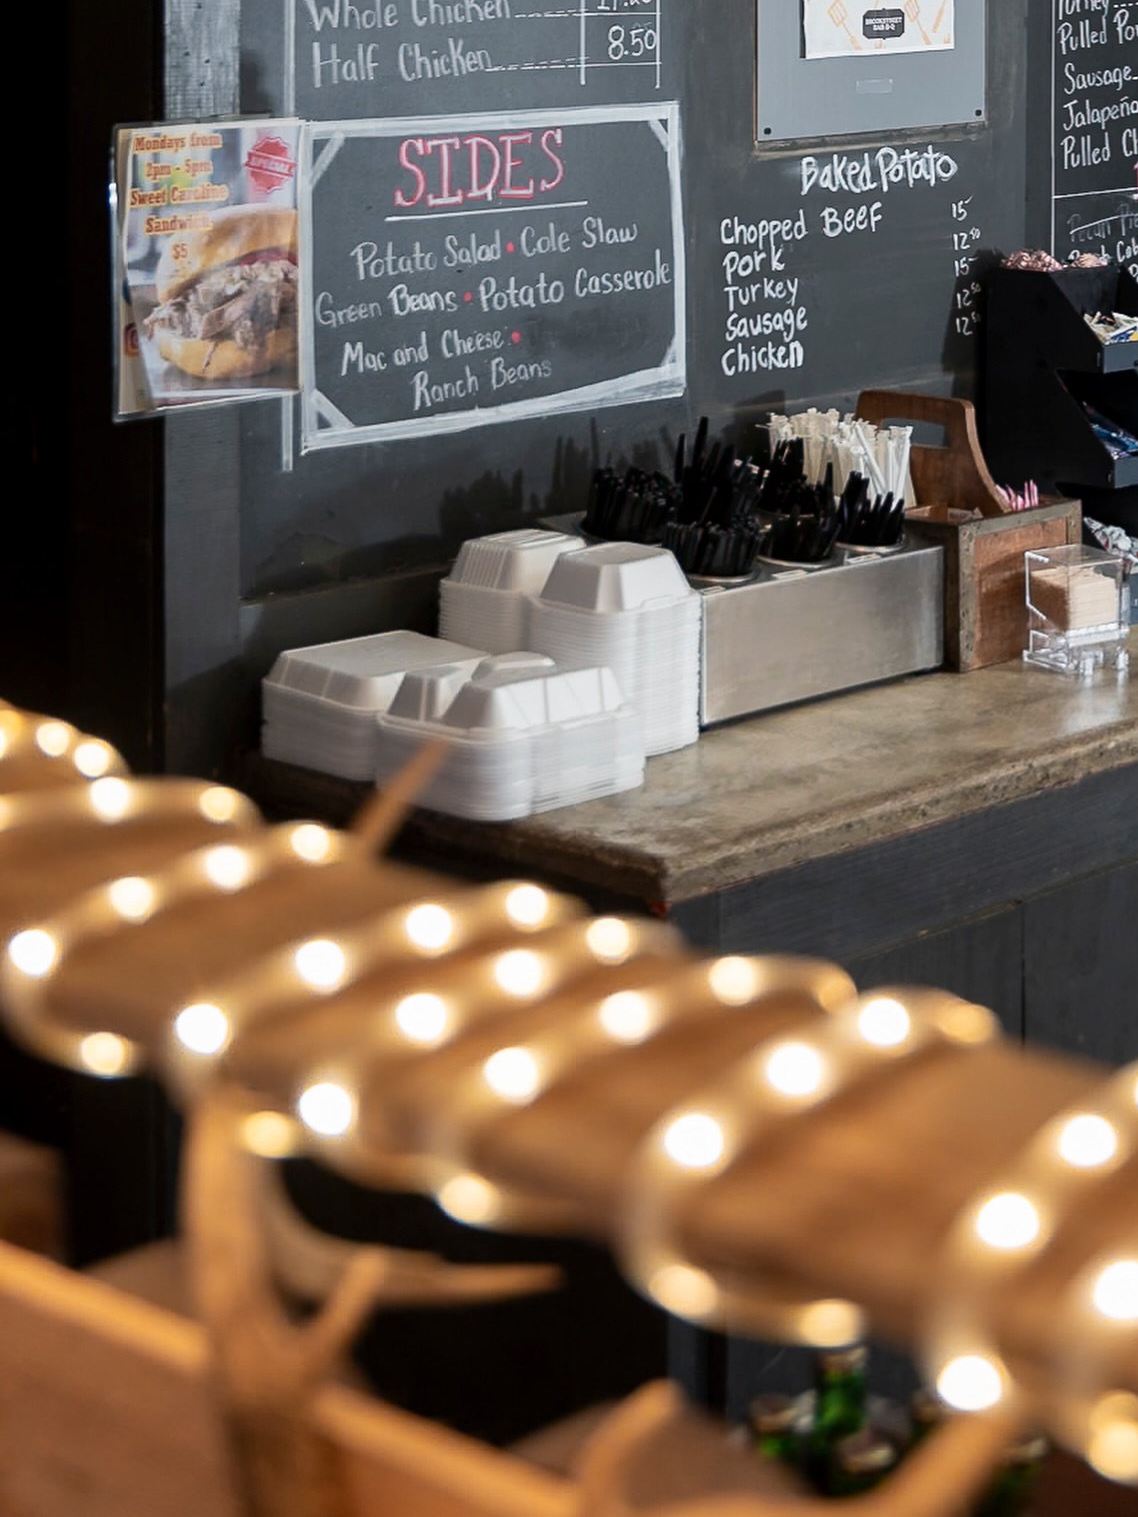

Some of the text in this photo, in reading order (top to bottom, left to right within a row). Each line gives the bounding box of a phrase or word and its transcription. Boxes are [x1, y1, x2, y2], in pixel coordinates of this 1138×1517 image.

[1057, 16, 1107, 55] Pulled
[312, 25, 658, 88] Half Chicken 8.50
[1064, 62, 1132, 94] Sausage
[135, 135, 186, 152] Mondays
[1060, 132, 1111, 170] Pulled
[394, 128, 566, 207] SIDES
[800, 144, 958, 195] Baked Potato
[129, 189, 166, 206] Sweet
[350, 216, 638, 280] Potato Salad Cole Slaw
[720, 209, 808, 248] Chopped
[722, 245, 785, 284] Pork
[315, 249, 672, 328] Green Beans Potato Casserole
[724, 278, 798, 311] Turkey
[725, 306, 807, 342] Sausage
[341, 329, 502, 376] Mac and Cheese
[721, 341, 803, 376] Chicken
[412, 356, 552, 411] Ranch Beans
